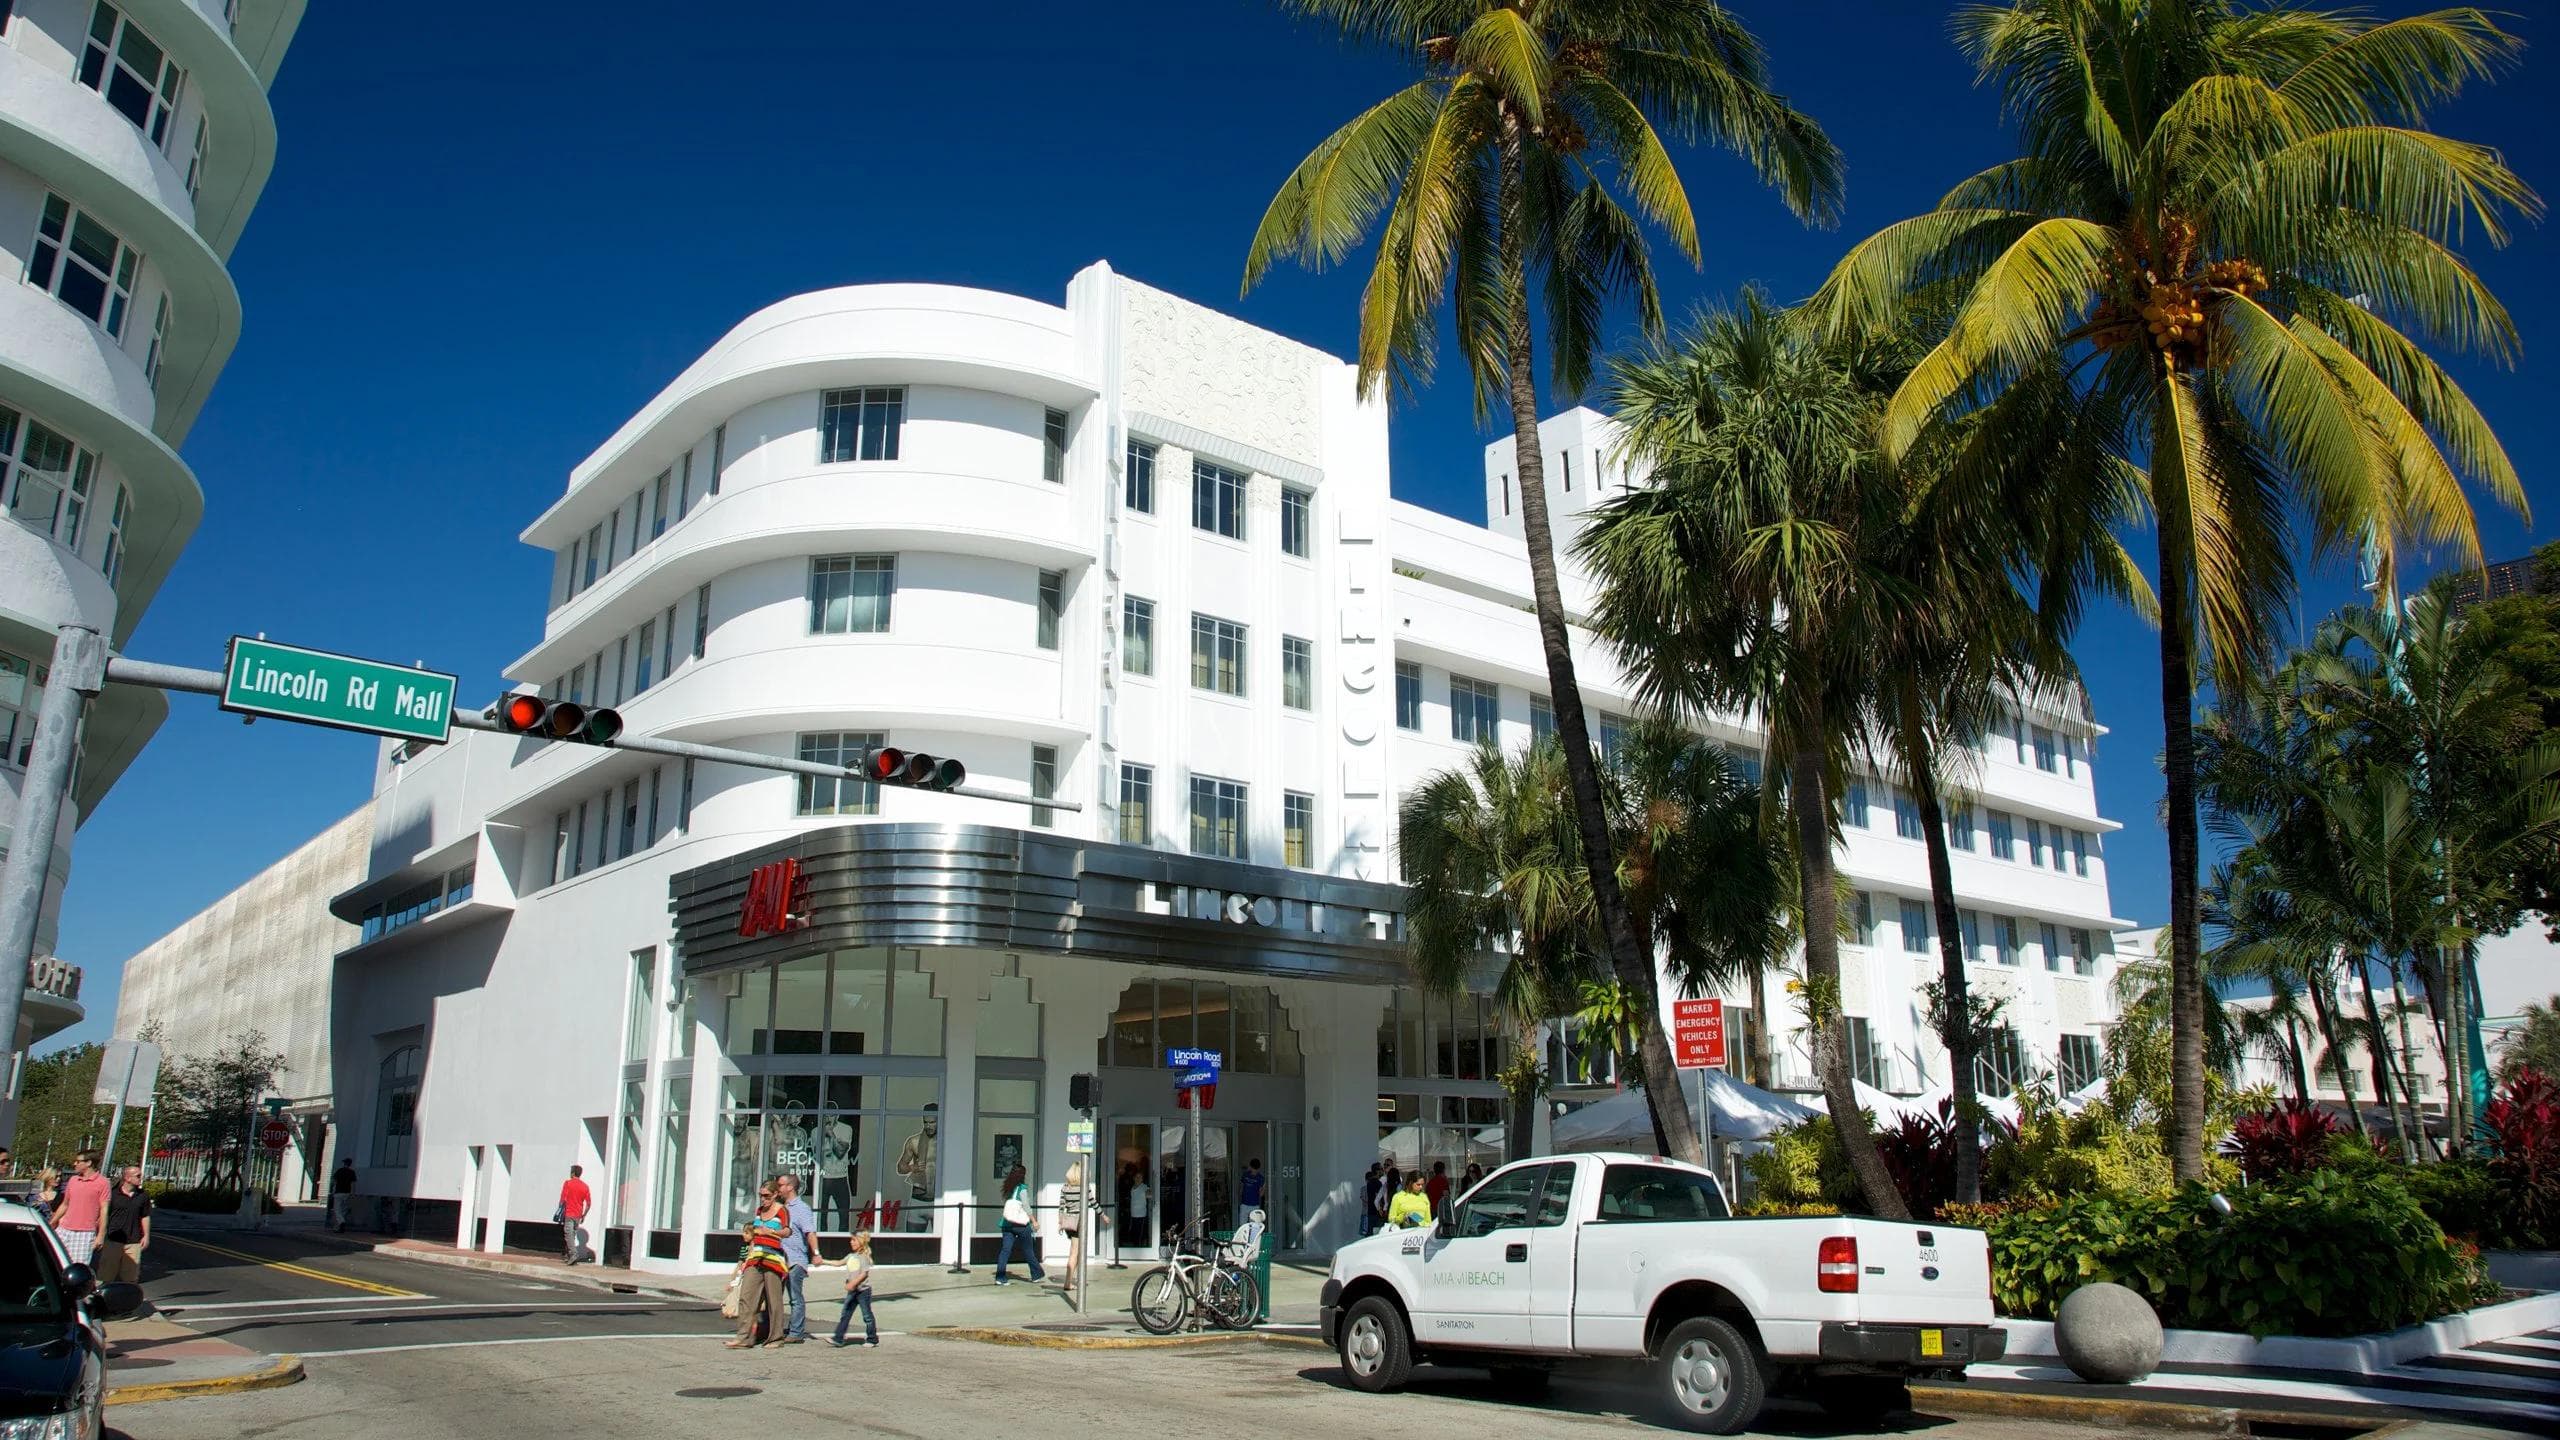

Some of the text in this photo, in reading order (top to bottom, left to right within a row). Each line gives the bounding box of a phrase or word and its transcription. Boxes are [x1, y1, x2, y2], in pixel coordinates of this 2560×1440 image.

[240, 657, 443, 722] Lincoln Rd Mall
[1144, 880, 1340, 935] LINCOLN
[33, 955, 76, 995] OFF
[1682, 1004, 1713, 1014] MARKED
[1676, 1017, 1721, 1029] EMERGENCY
[1681, 1030, 1718, 1042] VEHICLES
[1174, 1050, 1221, 1062] Lincoln Road
[1690, 1045, 1710, 1055] ONLY
[263, 1130, 289, 1140] STOP
[1282, 1165, 1300, 1178] 551
[1402, 1235, 1424, 1247] 4600
[1919, 1249, 1939, 1262] 4600
[1436, 1320, 1475, 1330] SANITATION
